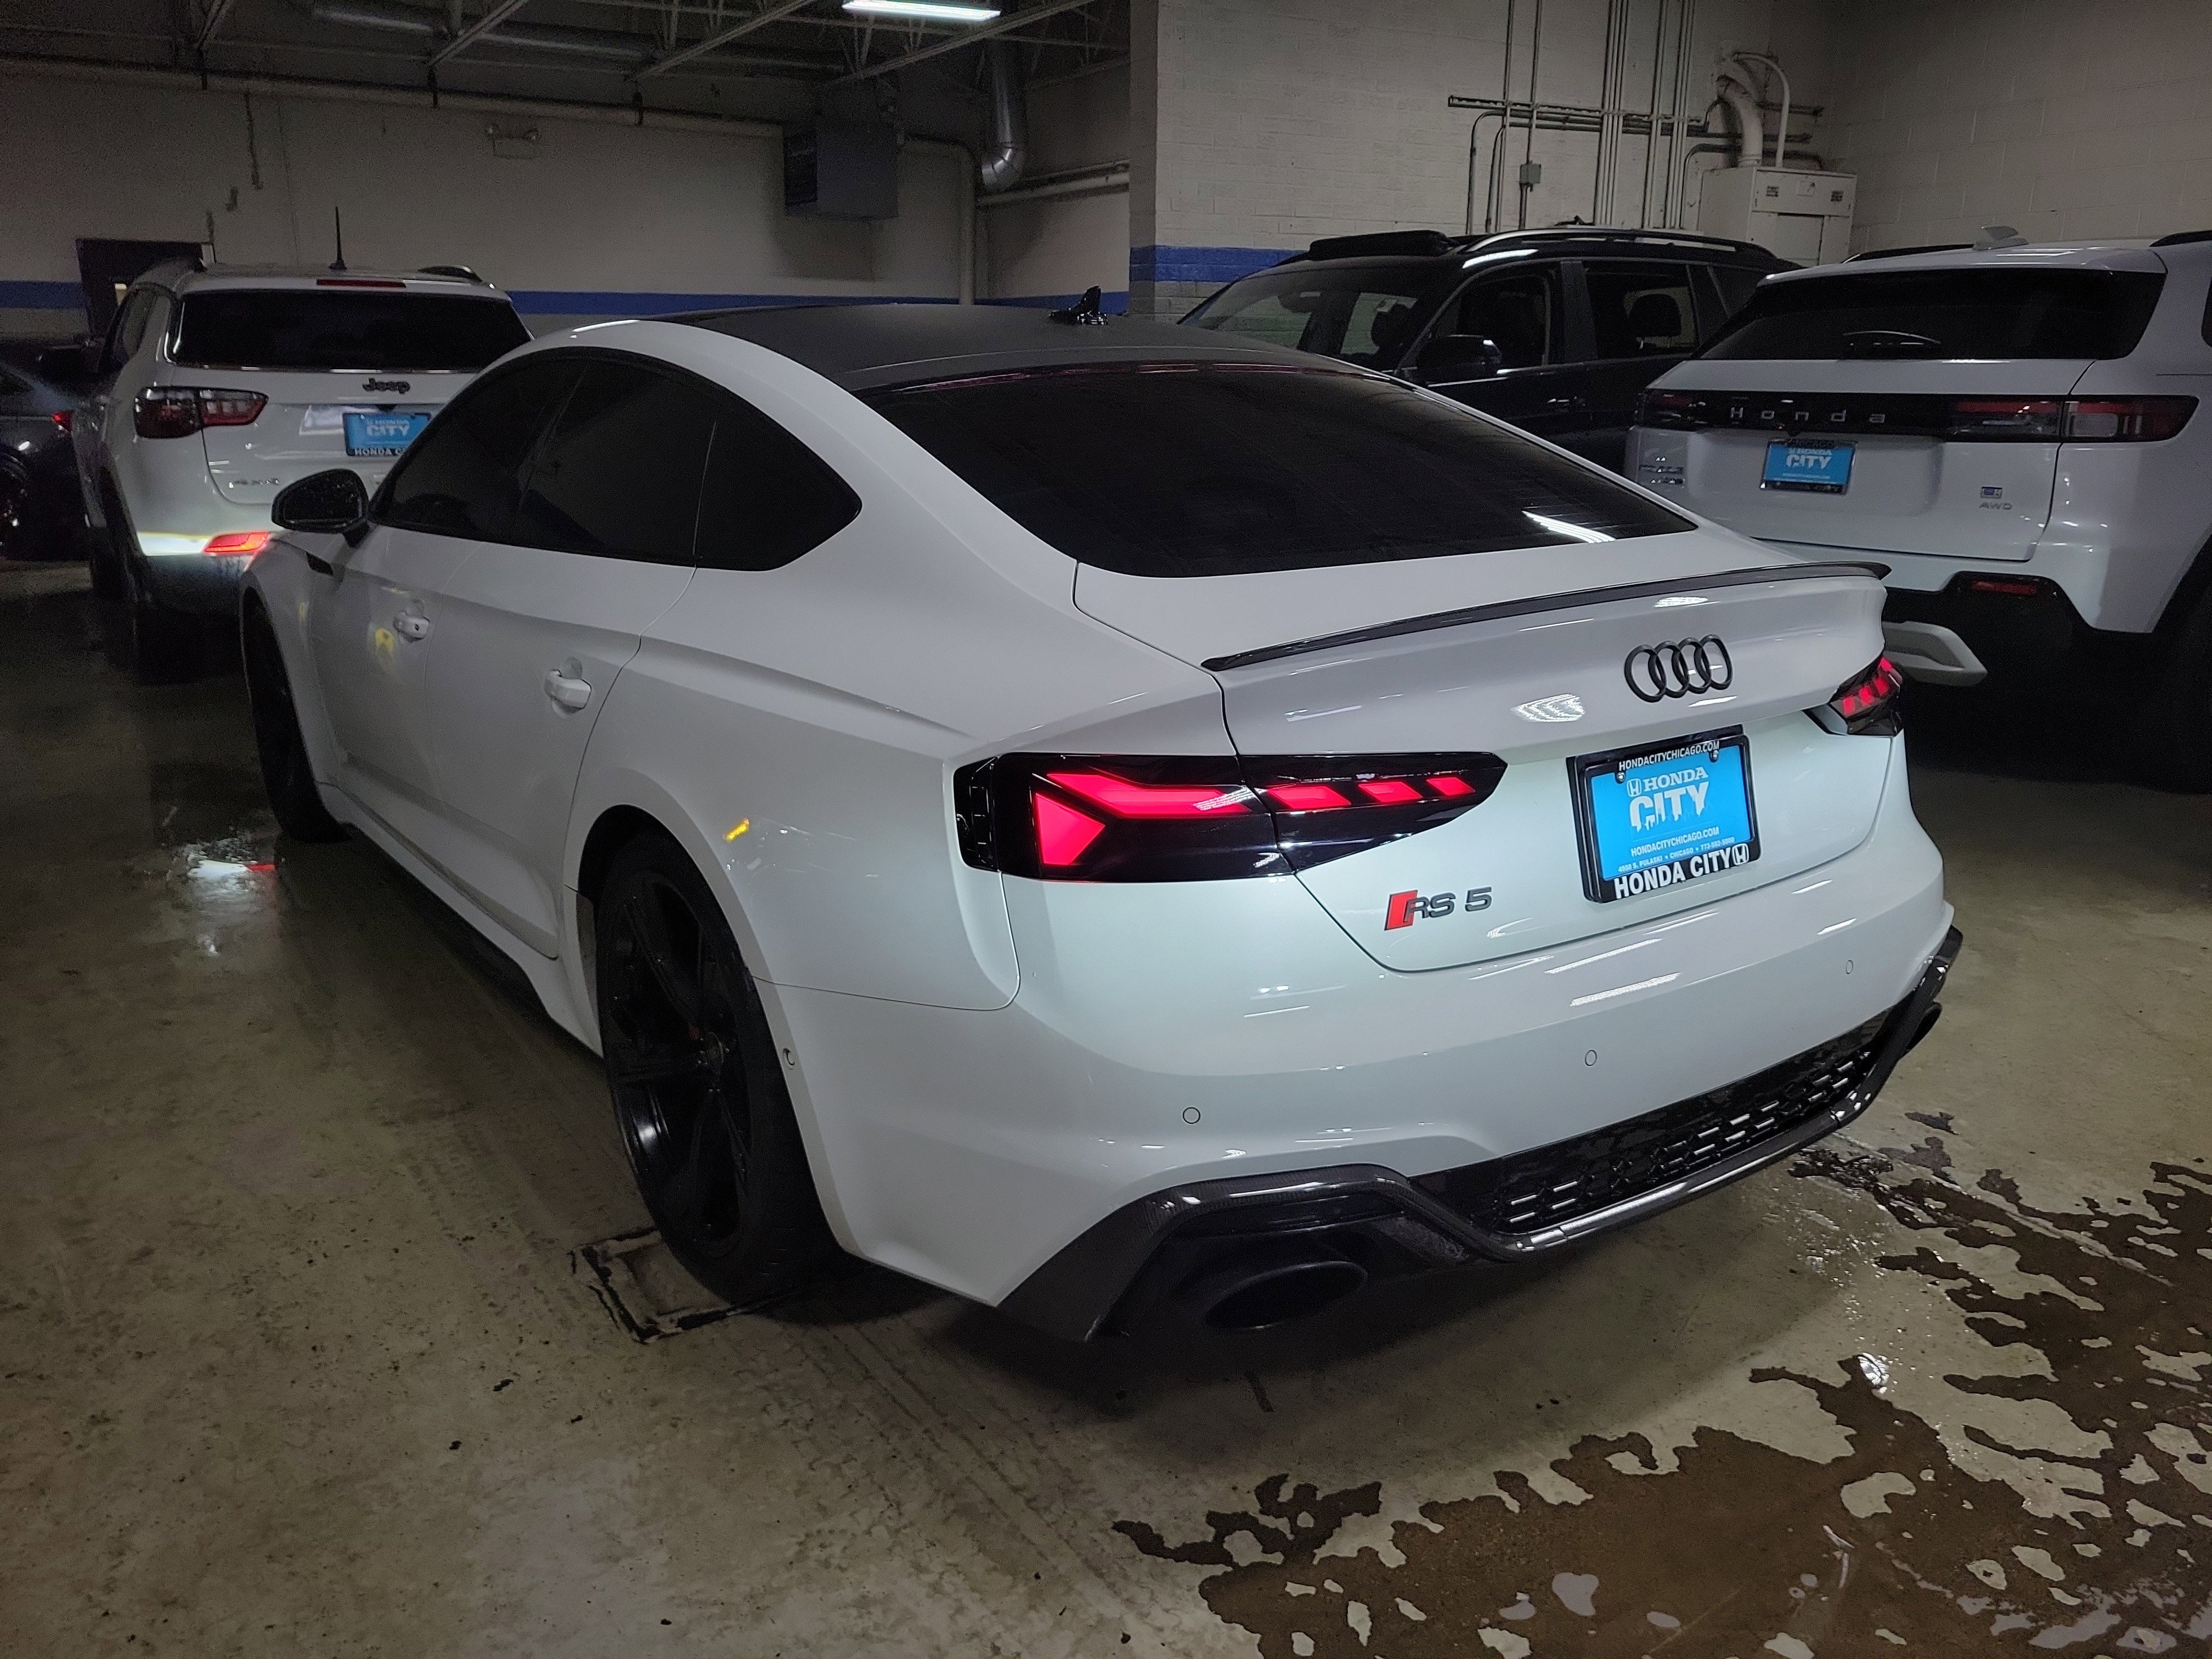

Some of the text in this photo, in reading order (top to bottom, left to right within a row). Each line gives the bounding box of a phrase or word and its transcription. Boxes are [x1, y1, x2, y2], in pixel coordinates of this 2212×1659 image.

[362, 377, 410, 394] Jeep
[1786, 454, 1832, 469] CITY
[1619, 741, 1720, 771] HONDACITYCHICAGO.COM
[1643, 766, 1709, 792] HONDA
[1629, 781, 1709, 832] CITY
[1630, 827, 1720, 857] HONDACITYCHICAGO.COM
[1613, 861, 1686, 899] HONDA
[1690, 847, 1731, 878] CITY
[1402, 886, 1492, 923] RS 5
